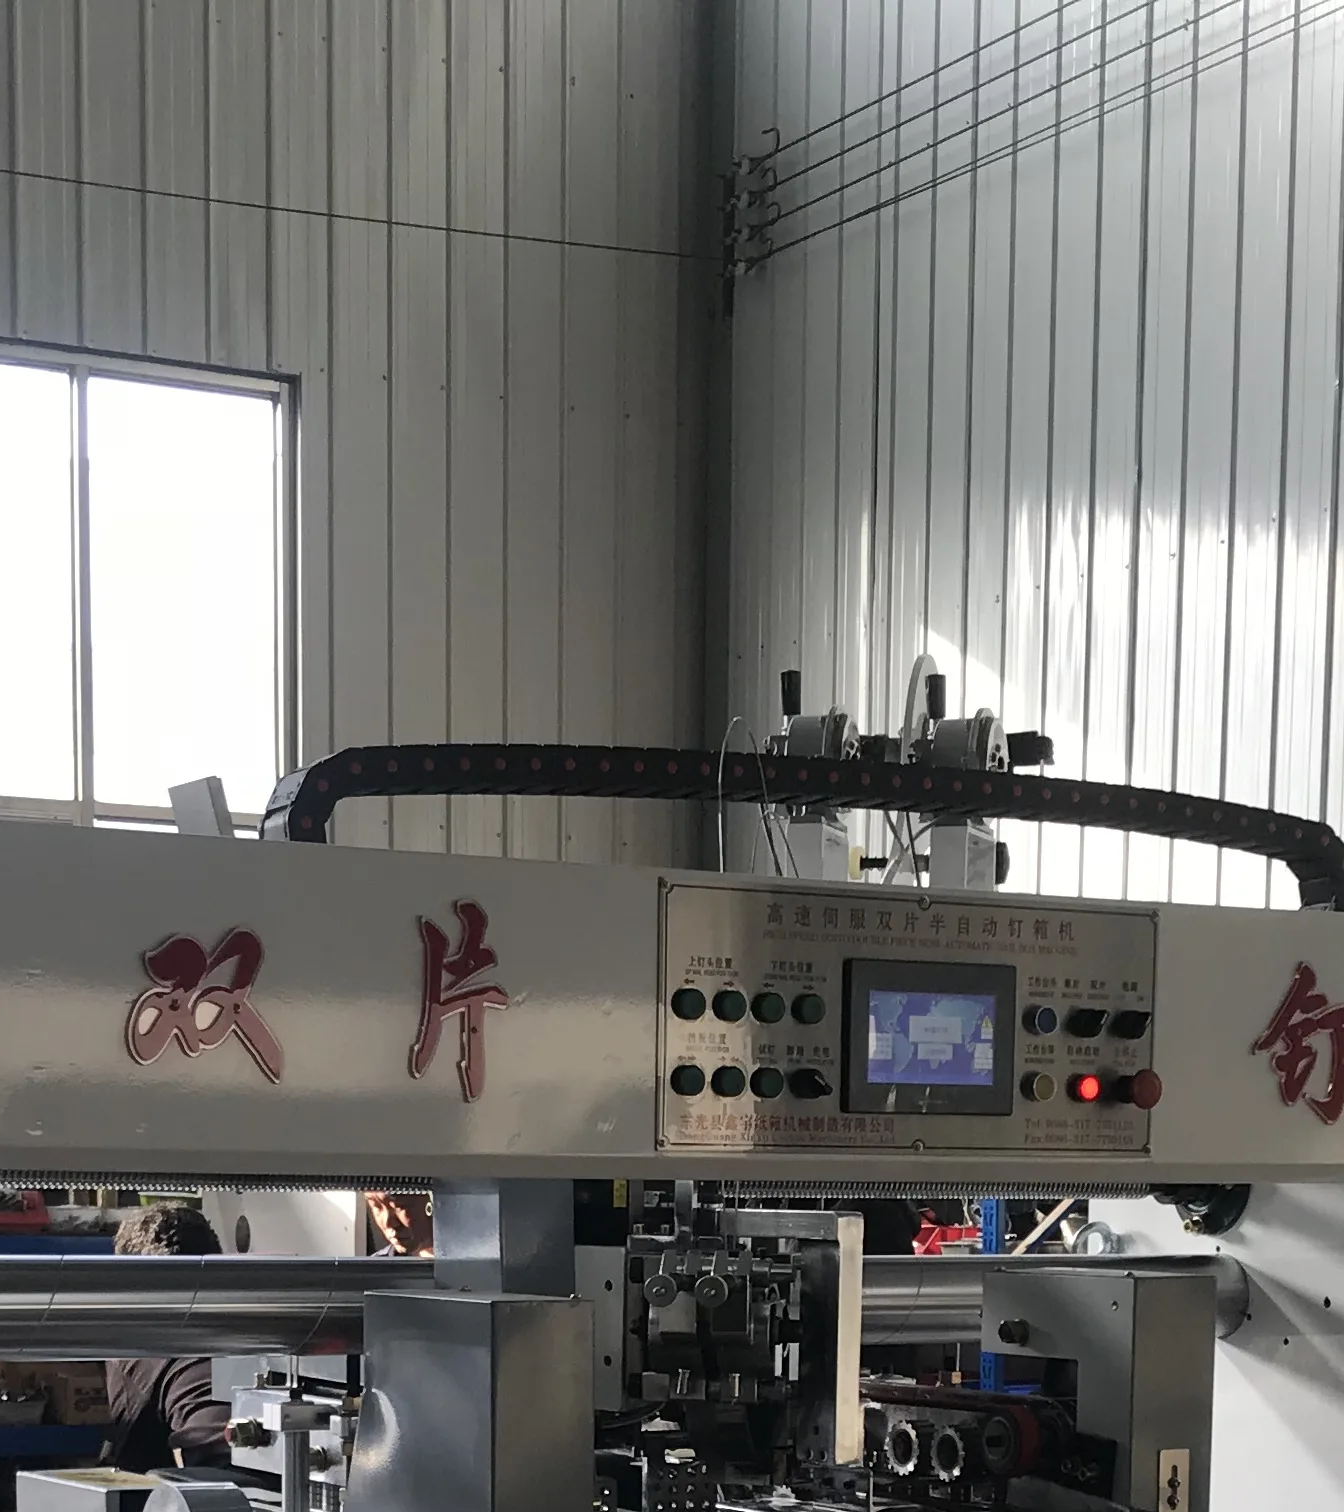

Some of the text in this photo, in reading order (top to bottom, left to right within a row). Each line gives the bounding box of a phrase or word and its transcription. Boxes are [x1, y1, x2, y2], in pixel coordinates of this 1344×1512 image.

[766, 901, 1076, 943] 高速伺服双片半自动钉箱机
